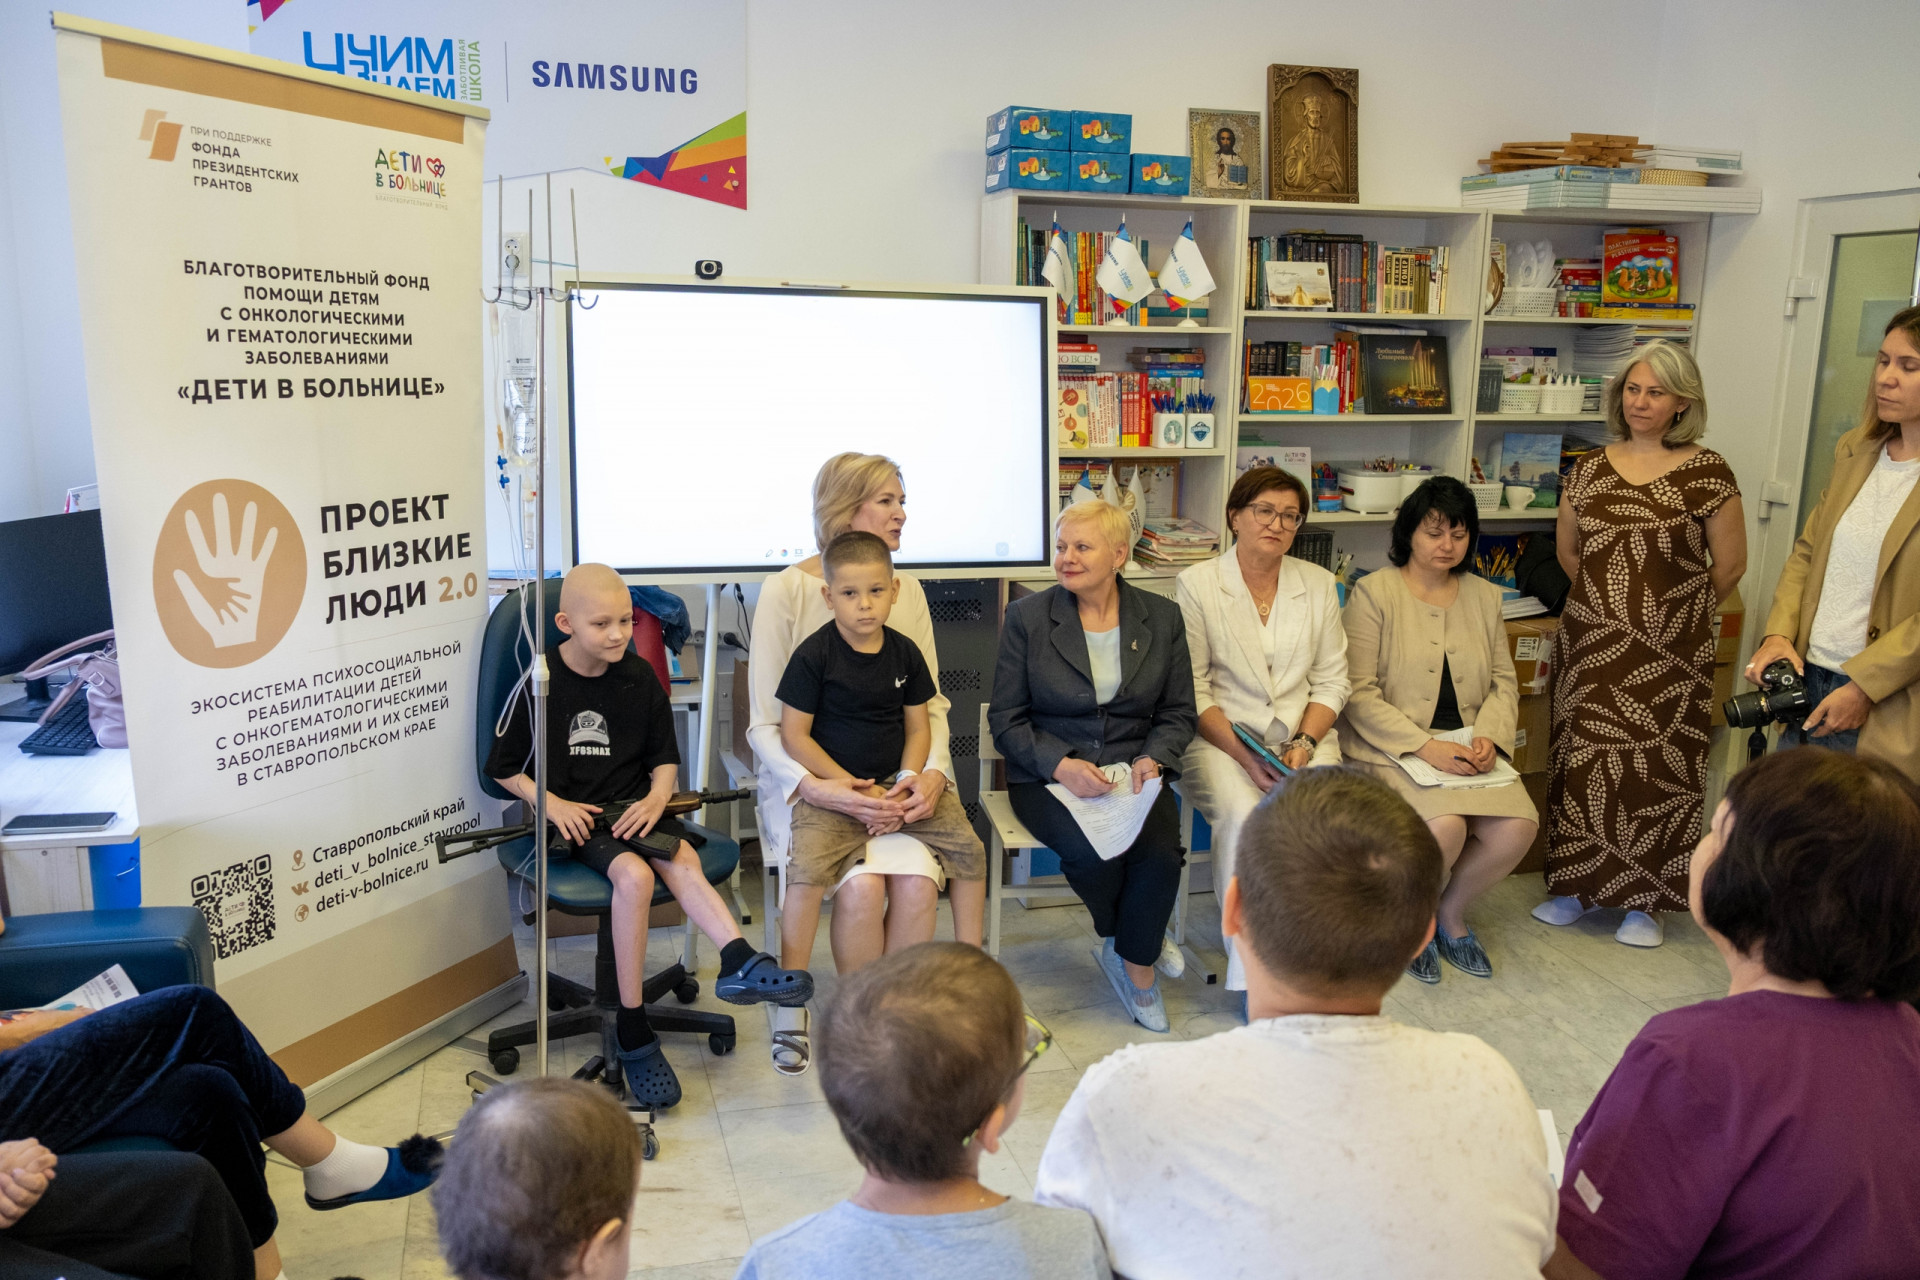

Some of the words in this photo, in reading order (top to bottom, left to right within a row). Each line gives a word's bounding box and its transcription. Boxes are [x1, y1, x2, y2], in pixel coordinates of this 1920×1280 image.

[458, 39, 468, 101] ЗАБОТЛИВАЯ
[468, 40, 482, 101] ШКОЛА
[532, 60, 698, 95] SAMSUNG
[190, 125, 210, 138] ПРИ
[212, 130, 272, 147] ПОДДЕРЖКЕ
[191, 141, 241, 158] ФОНДА
[192, 158, 300, 184] ПРЕЗИДЕНТСКИХ
[375, 148, 423, 174] ДЕТИ
[193, 176, 253, 193] ГРАНТОВ
[376, 173, 384, 187] В
[389, 174, 447, 199] БОЛЬНИЦЕ
[183, 260, 380, 286] БЛАГОТВОРИТЕЛЬНЫЙ
[384, 274, 430, 291] ФОНД
[244, 285, 323, 305] ПОМОЩИ
[329, 290, 380, 306] ДЕТЯМ
[220, 306, 232, 320] С
[239, 307, 405, 327] ОНКОЛОГИЧЕСКИМИ
[207, 328, 220, 342] И
[227, 329, 413, 346] ГЕМАТОЛОГИЧЕСКИМИ
[245, 350, 389, 365] ЗАБОЛЕВАНИЯМИ
[177, 378, 267, 405] «ДЕТИ
[277, 378, 294, 399] В
[303, 377, 445, 400] БОЛЬНИЦЕ»
[1251, 382, 1310, 411] 2026
[320, 493, 449, 534] ПРОЕКТ
[323, 532, 471, 579] БЛИЗКИЕ
[326, 580, 426, 625] ЛЮДИ
[438, 572, 478, 603] 2.0
[191, 677, 308, 715] ЭКОСИСТЕМА
[313, 639, 462, 687] ПСИХОСОЦИАЛЬНОЙ
[248, 680, 375, 723] РЕАБИЛИТАЦИИ
[380, 665, 422, 691] ДЕТЕЙ
[216, 736, 227, 750] С
[233, 680, 448, 746] ОНКОГЕМАТОЛОГИЧЕСКИМИ
[216, 720, 362, 771] ЗАБОЛЕВАНИЯМИ
[367, 717, 377, 730] И
[383, 711, 401, 726] ИХ
[404, 695, 449, 720] СЕМЕЙ
[237, 772, 248, 786] В
[253, 729, 400, 782] СТАВРОПОЛЬСКОМ
[404, 717, 437, 738] КРАЕ
[312, 809, 431, 863] Ставропольский
[433, 797, 466, 821] край
[314, 813, 481, 889] deti_v_bolnice_stavropol
[316, 859, 429, 913] deti-v-bolnice.ru
